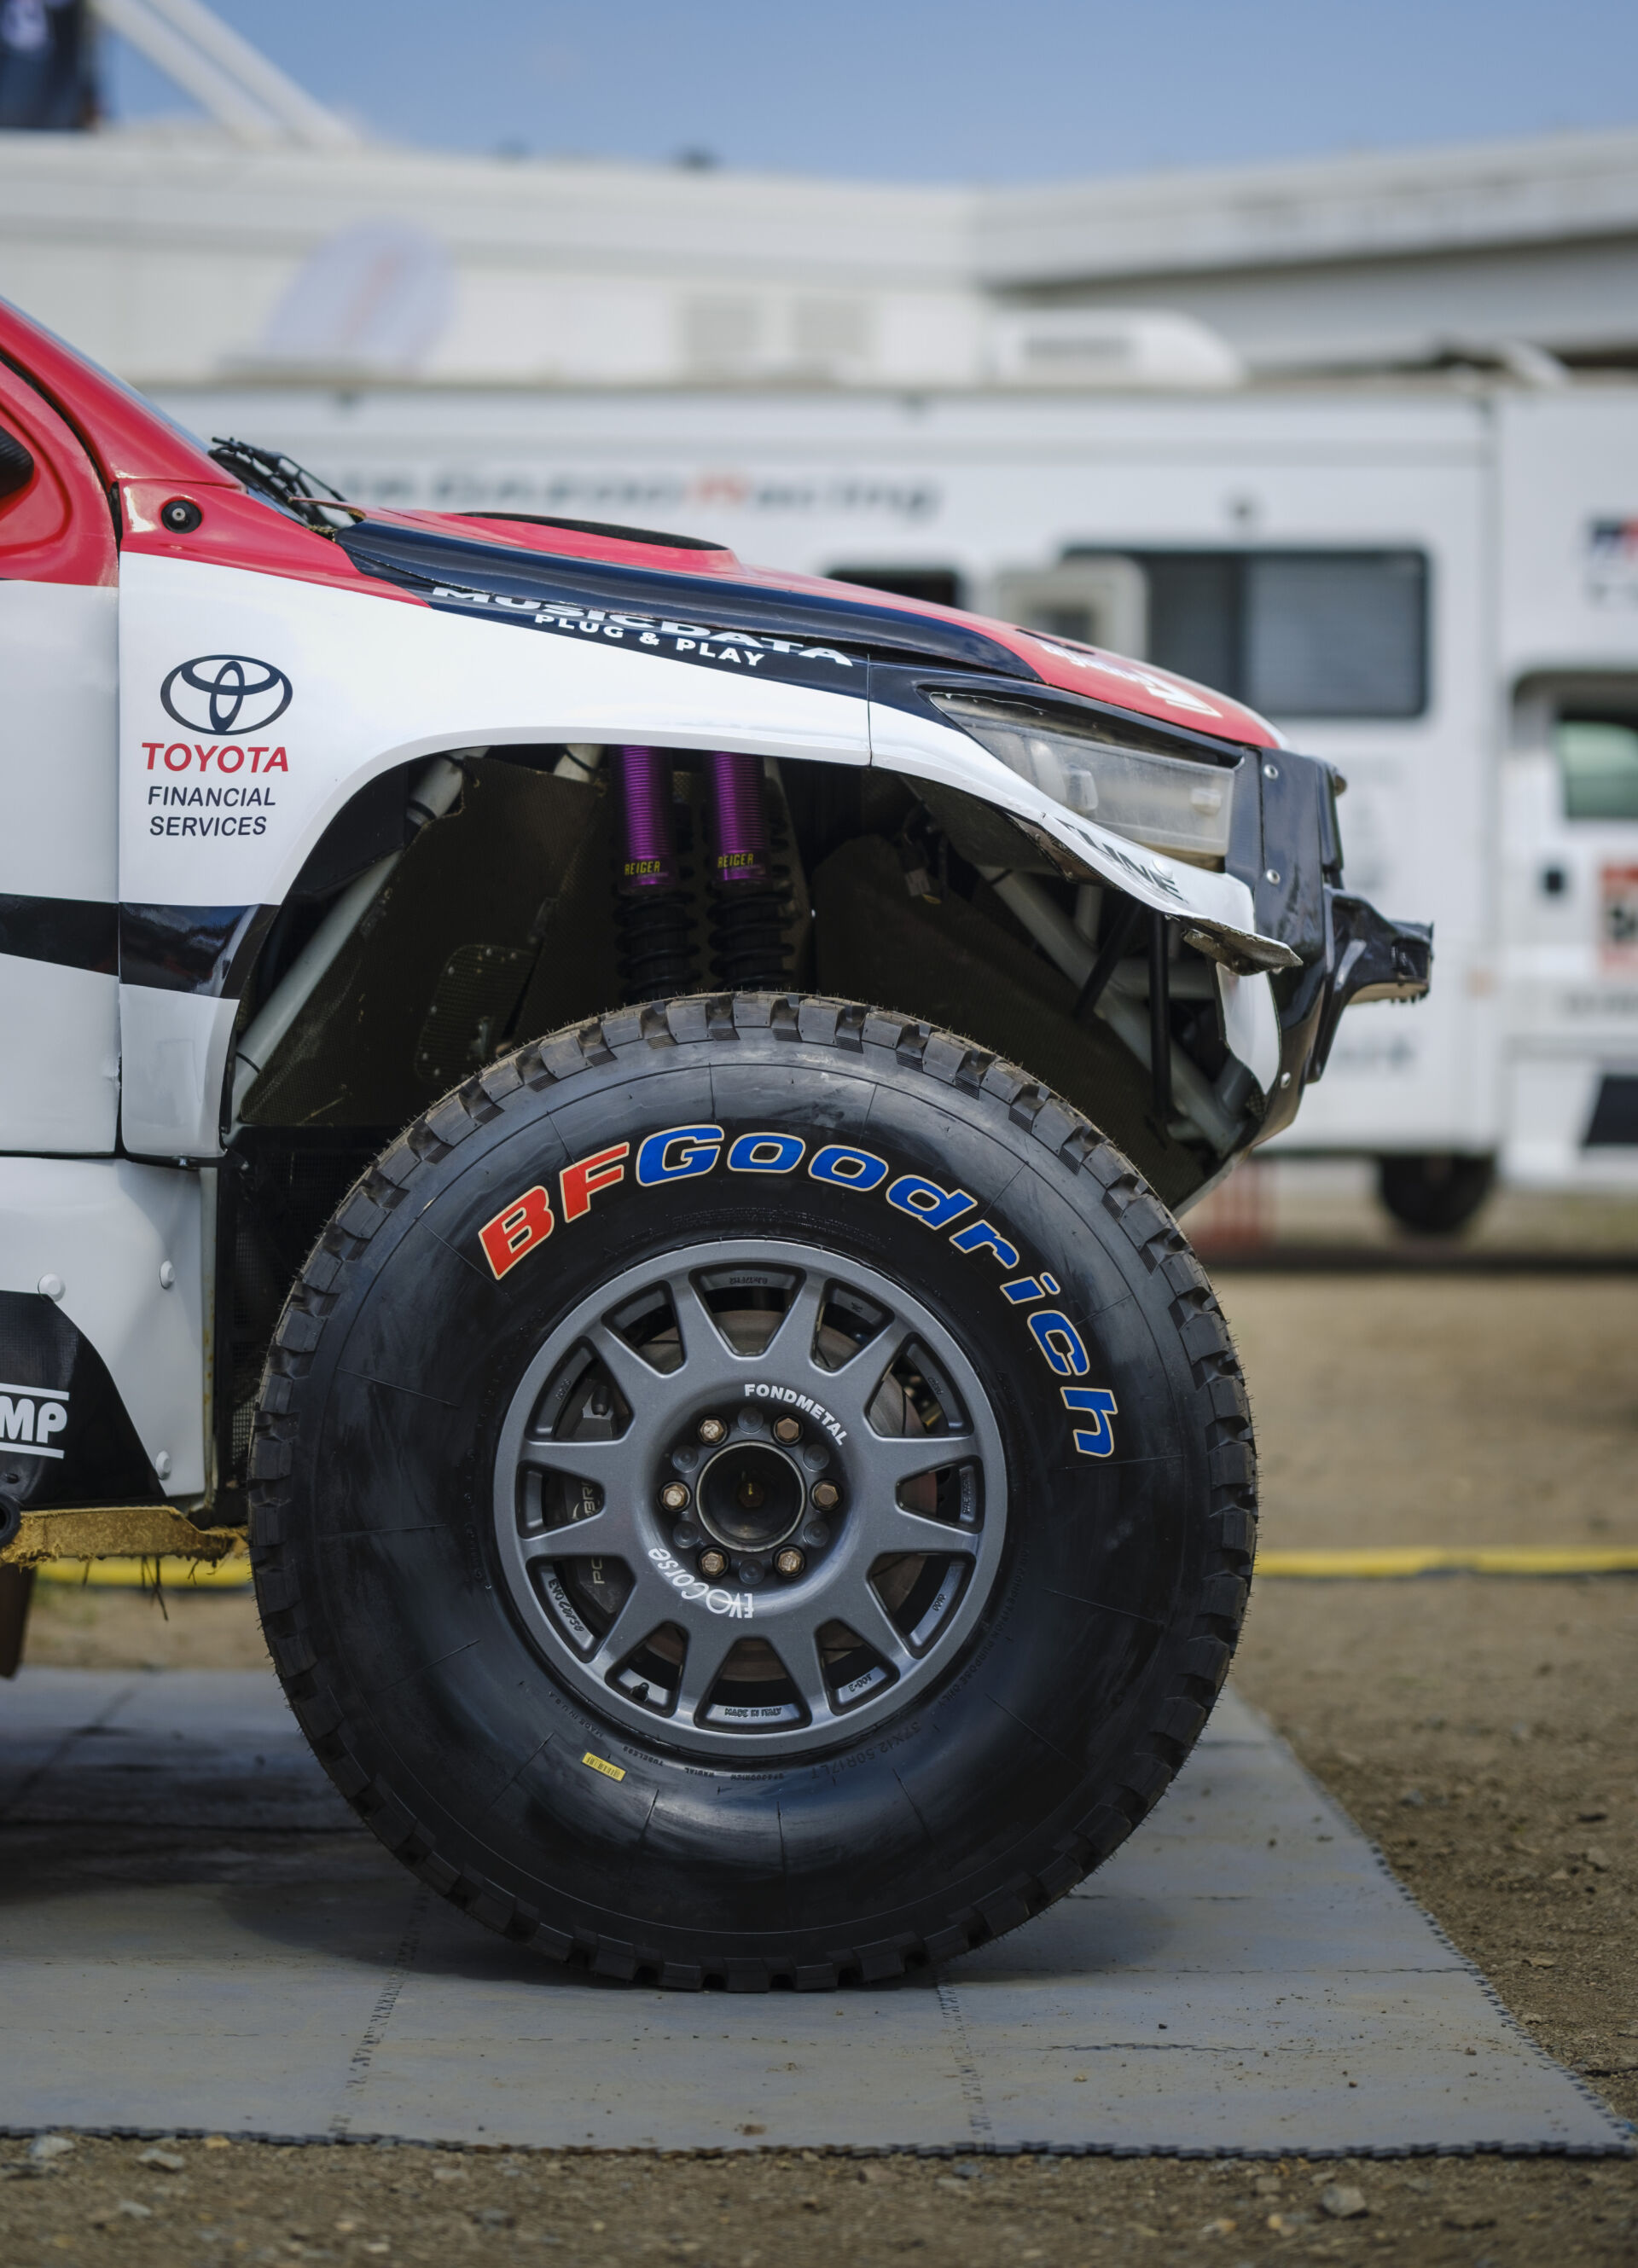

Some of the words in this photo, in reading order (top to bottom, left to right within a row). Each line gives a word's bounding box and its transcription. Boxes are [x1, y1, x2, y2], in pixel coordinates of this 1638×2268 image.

[431, 585, 854, 668] MUSICDATA
[533, 613, 624, 640] PLUG
[638, 630, 660, 647] &
[675, 638, 766, 667] PLAY
[141, 742, 289, 774] TOYOTA
[147, 786, 276, 807] FINANCIAL
[148, 815, 267, 837] SERVICES
[624, 860, 661, 876] REIGER
[717, 853, 754, 869] REIGER
[478, 1123, 1118, 1459] BFGoodrich
[744, 1383, 848, 1447] FONDMETAL
[960, 1636, 996, 1683] PURPOSE
[566, 1708, 579, 1721] IN
[576, 1716, 604, 1739] MADE
